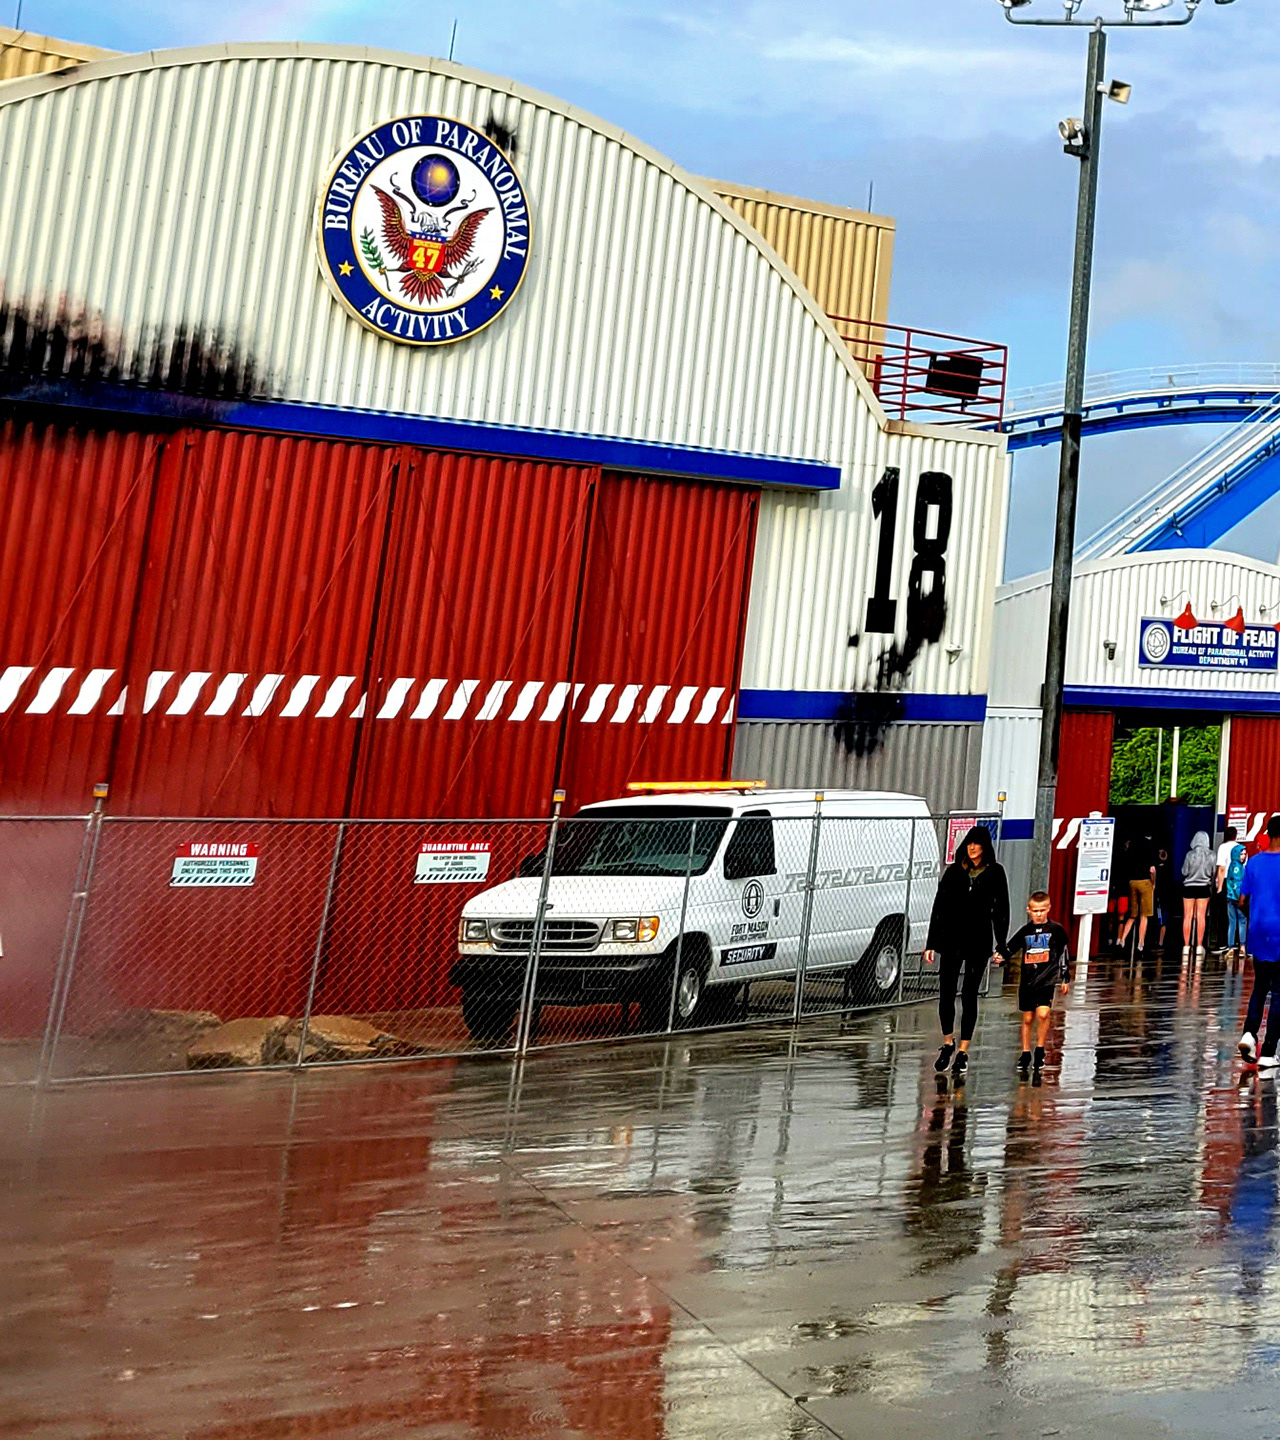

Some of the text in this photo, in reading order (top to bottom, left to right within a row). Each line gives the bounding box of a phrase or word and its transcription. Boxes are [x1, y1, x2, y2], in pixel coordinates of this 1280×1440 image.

[325, 118, 528, 261] BUREAU OF PARANORMAL
[412, 247, 440, 270] 47
[361, 296, 470, 339] ACTIVITY
[864, 466, 953, 644] 18
[1172, 625, 1221, 645] FLIGHT
[1242, 629, 1277, 648] FEAR
[190, 843, 248, 856] WARNING
[422, 842, 491, 853] QUARANTINE AREA
[731, 921, 770, 935] FORT MASON
[726, 946, 766, 964] SECURITY
